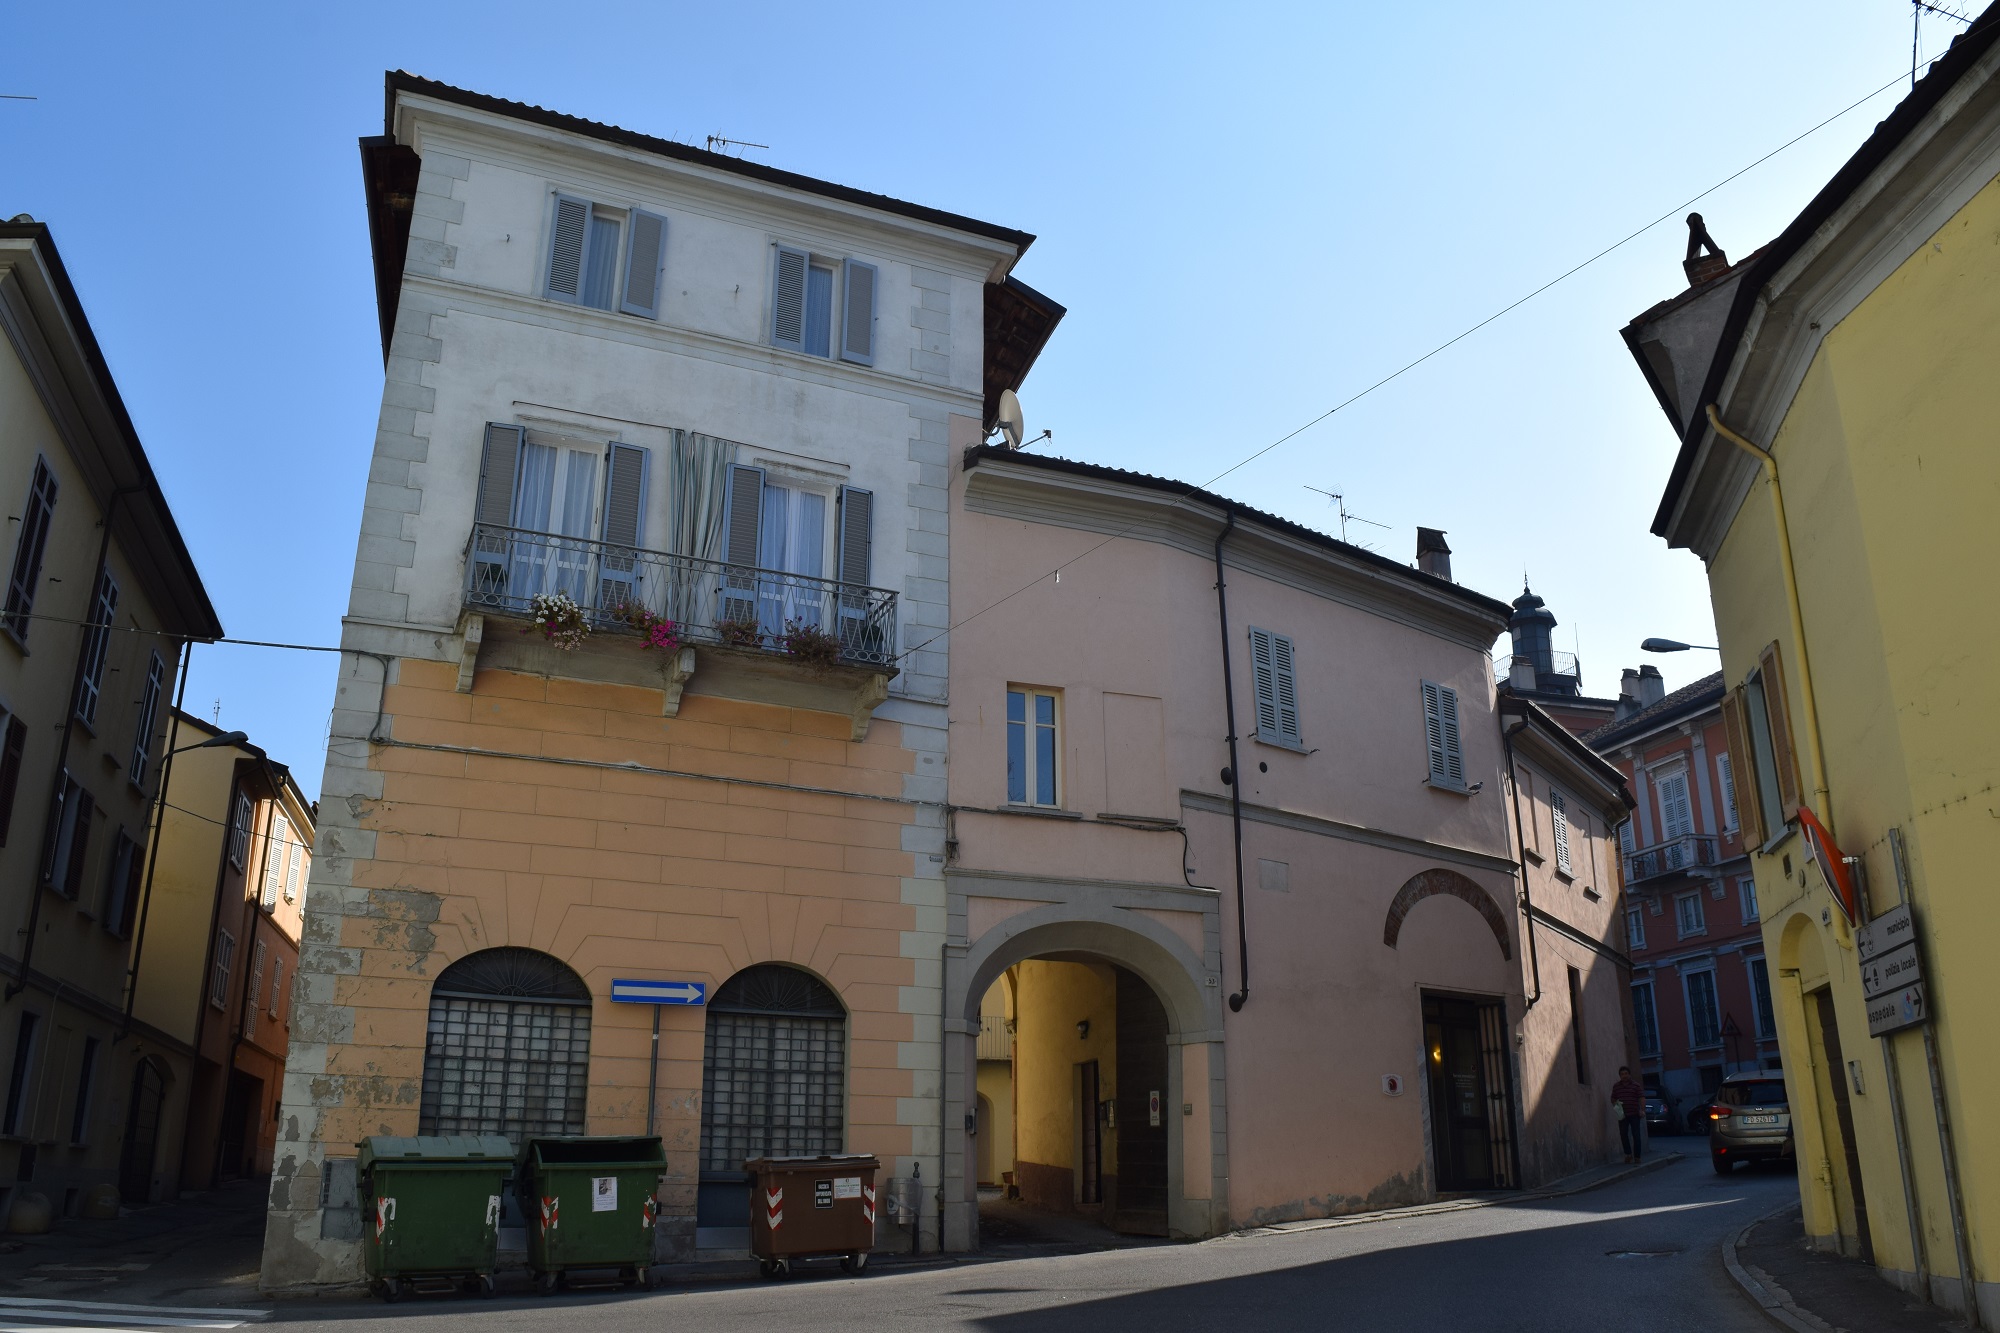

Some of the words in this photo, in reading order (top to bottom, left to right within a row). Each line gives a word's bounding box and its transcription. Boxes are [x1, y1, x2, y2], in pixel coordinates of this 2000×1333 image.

[1886, 915, 1910, 936] municipio
[1885, 962, 1900, 980] polizia
[1900, 955, 1916, 971] locale
[1868, 1003, 1895, 1024] ospedale
